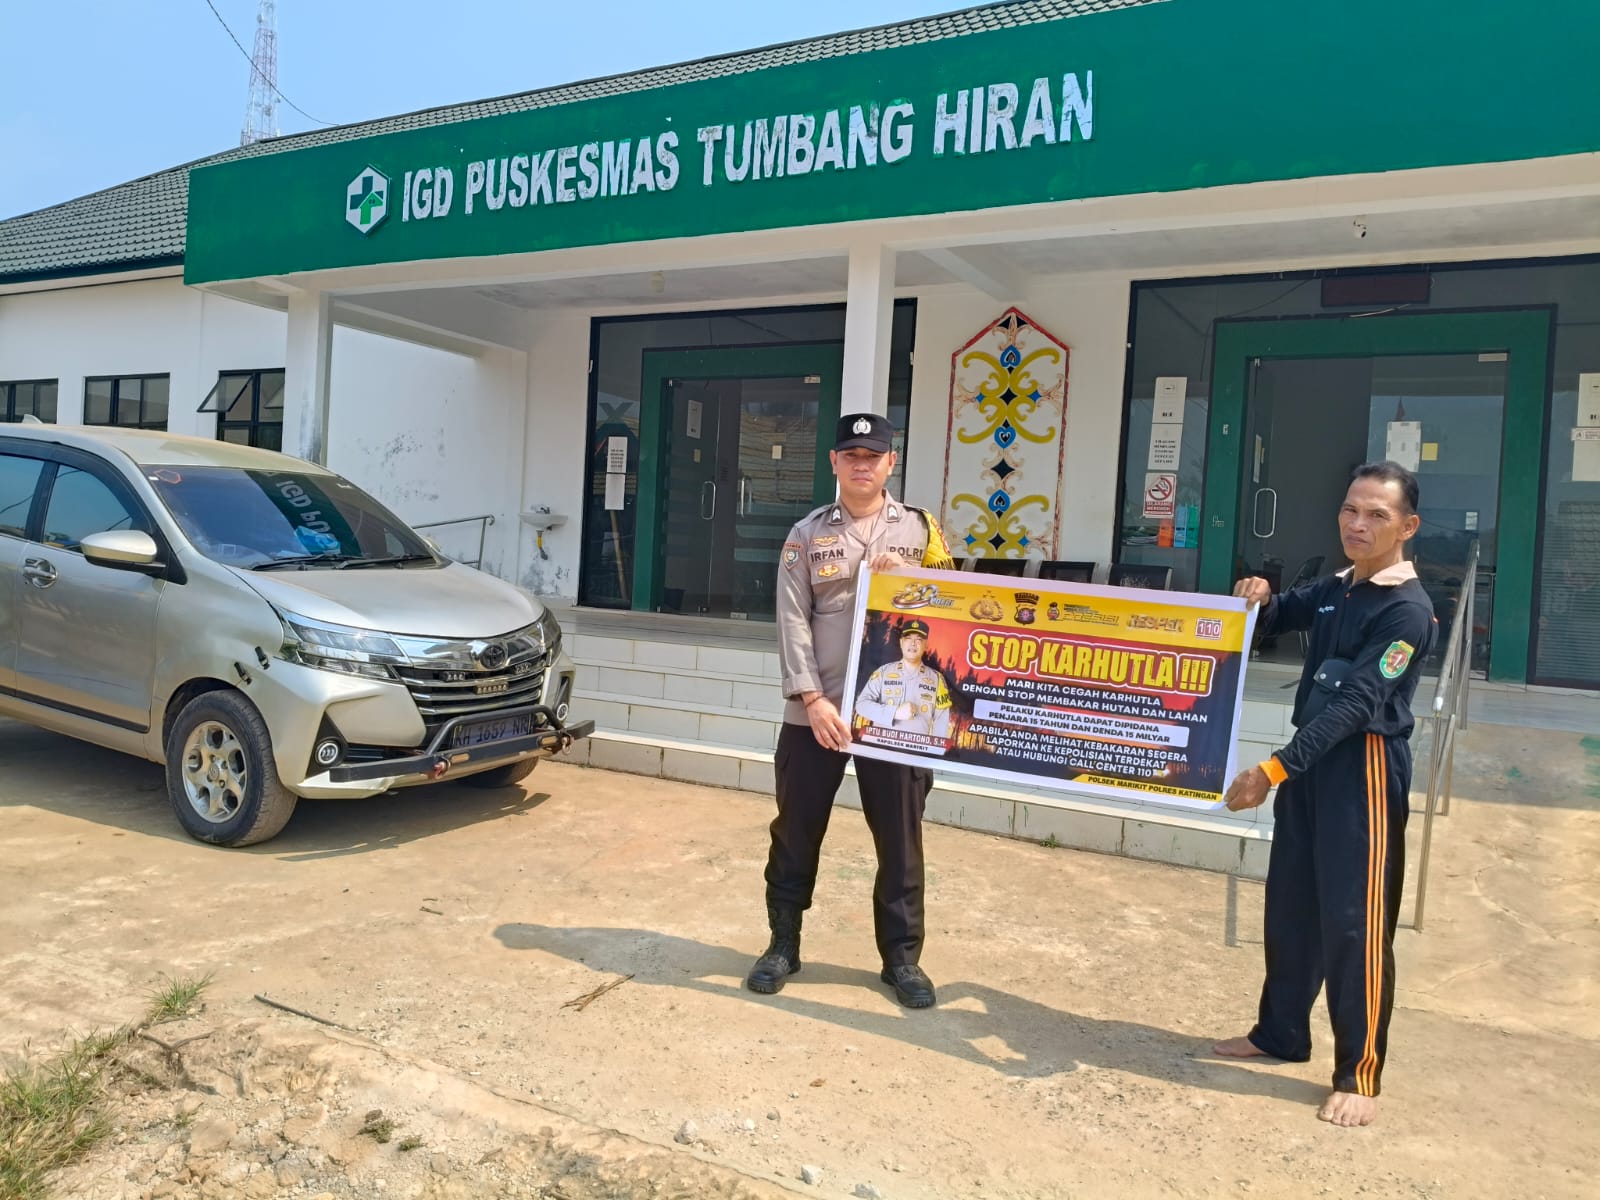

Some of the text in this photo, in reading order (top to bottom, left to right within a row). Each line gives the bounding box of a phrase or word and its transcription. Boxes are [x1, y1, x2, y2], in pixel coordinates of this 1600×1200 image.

[402, 70, 1094, 222] IGD PUSKESMAS TUMBANG HIRAN
[810, 548, 845, 563] IRFAN
[1199, 622, 1220, 635] 110
[972, 634, 1210, 692] STOP KARHUTLA !!!
[962, 683, 1208, 723] DENGAN STOP MEMBAKAR HUTAN DAN LAHAN
[1006, 678, 1161, 706] MARI KITA CEGAH KARHUTLA
[989, 711, 1028, 723] PENJARA
[1030, 717, 1038, 725] 15
[1040, 719, 1070, 730] TAHUN
[1071, 724, 1091, 732] DAN
[1092, 726, 1124, 737] DENDA
[1135, 732, 1170, 743] MILYAR
[1000, 704, 1160, 732] PELAKU KARHUTLA DAPAT DIPIDANA
[882, 729, 898, 739] BUDI
[969, 724, 1188, 762] APABILA ANDA MELIHAT KEBAKARAN SEGERA
[986, 736, 1167, 769] LAPORKAN KE KEPOLISIAN TERDEKAT
[996, 747, 1153, 777] ATAU HUBUNGI CALL CENTER 110
[1087, 776, 1218, 801] POLSEK MARIKIT POLRES KATINGAN
